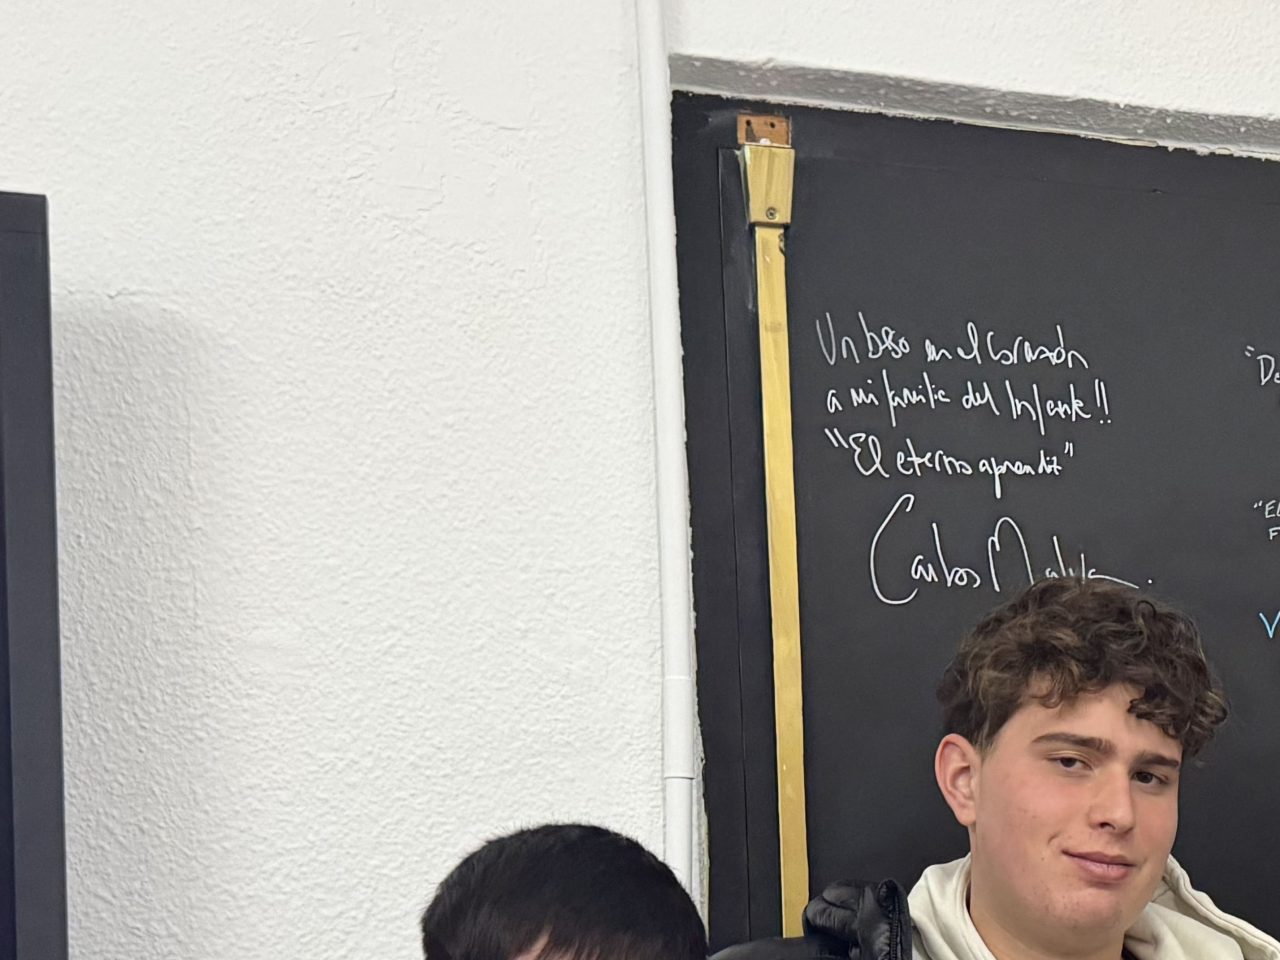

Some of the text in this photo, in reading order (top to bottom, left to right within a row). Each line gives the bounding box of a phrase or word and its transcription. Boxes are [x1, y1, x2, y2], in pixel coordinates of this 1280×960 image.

[816, 312, 859, 365] Un
[957, 321, 982, 365] el
[826, 389, 843, 413] a
[850, 379, 879, 407] mi
